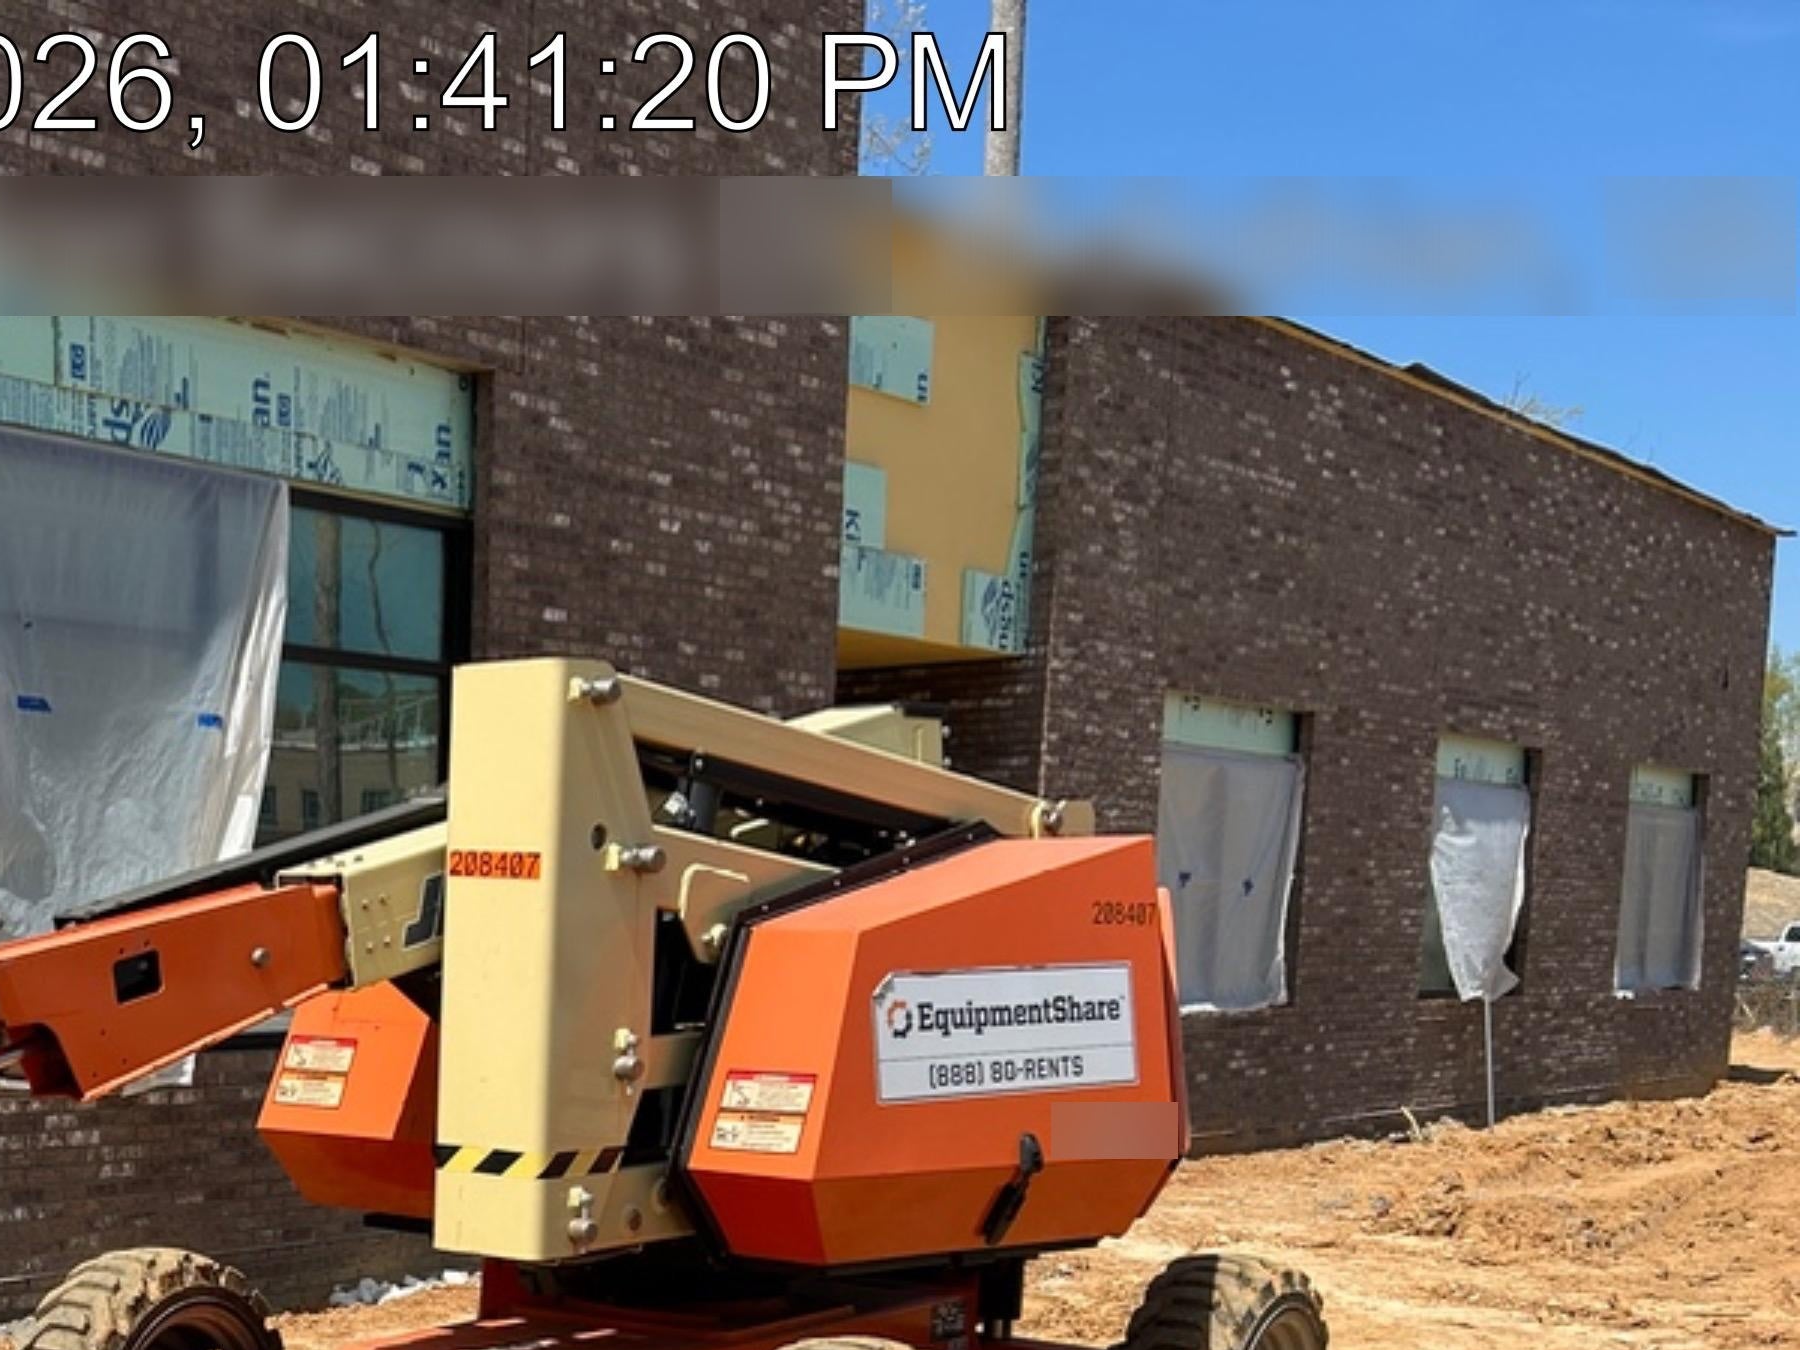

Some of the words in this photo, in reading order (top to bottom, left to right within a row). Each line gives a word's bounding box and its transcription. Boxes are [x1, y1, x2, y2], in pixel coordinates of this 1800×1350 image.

[449, 851, 541, 879] 208407
[1092, 902, 1158, 925] 208407
[916, 995, 1121, 1036] EquipmentShare
[929, 1061, 984, 1088] (888)
[990, 1056, 1084, 1082] 80-RENTS
